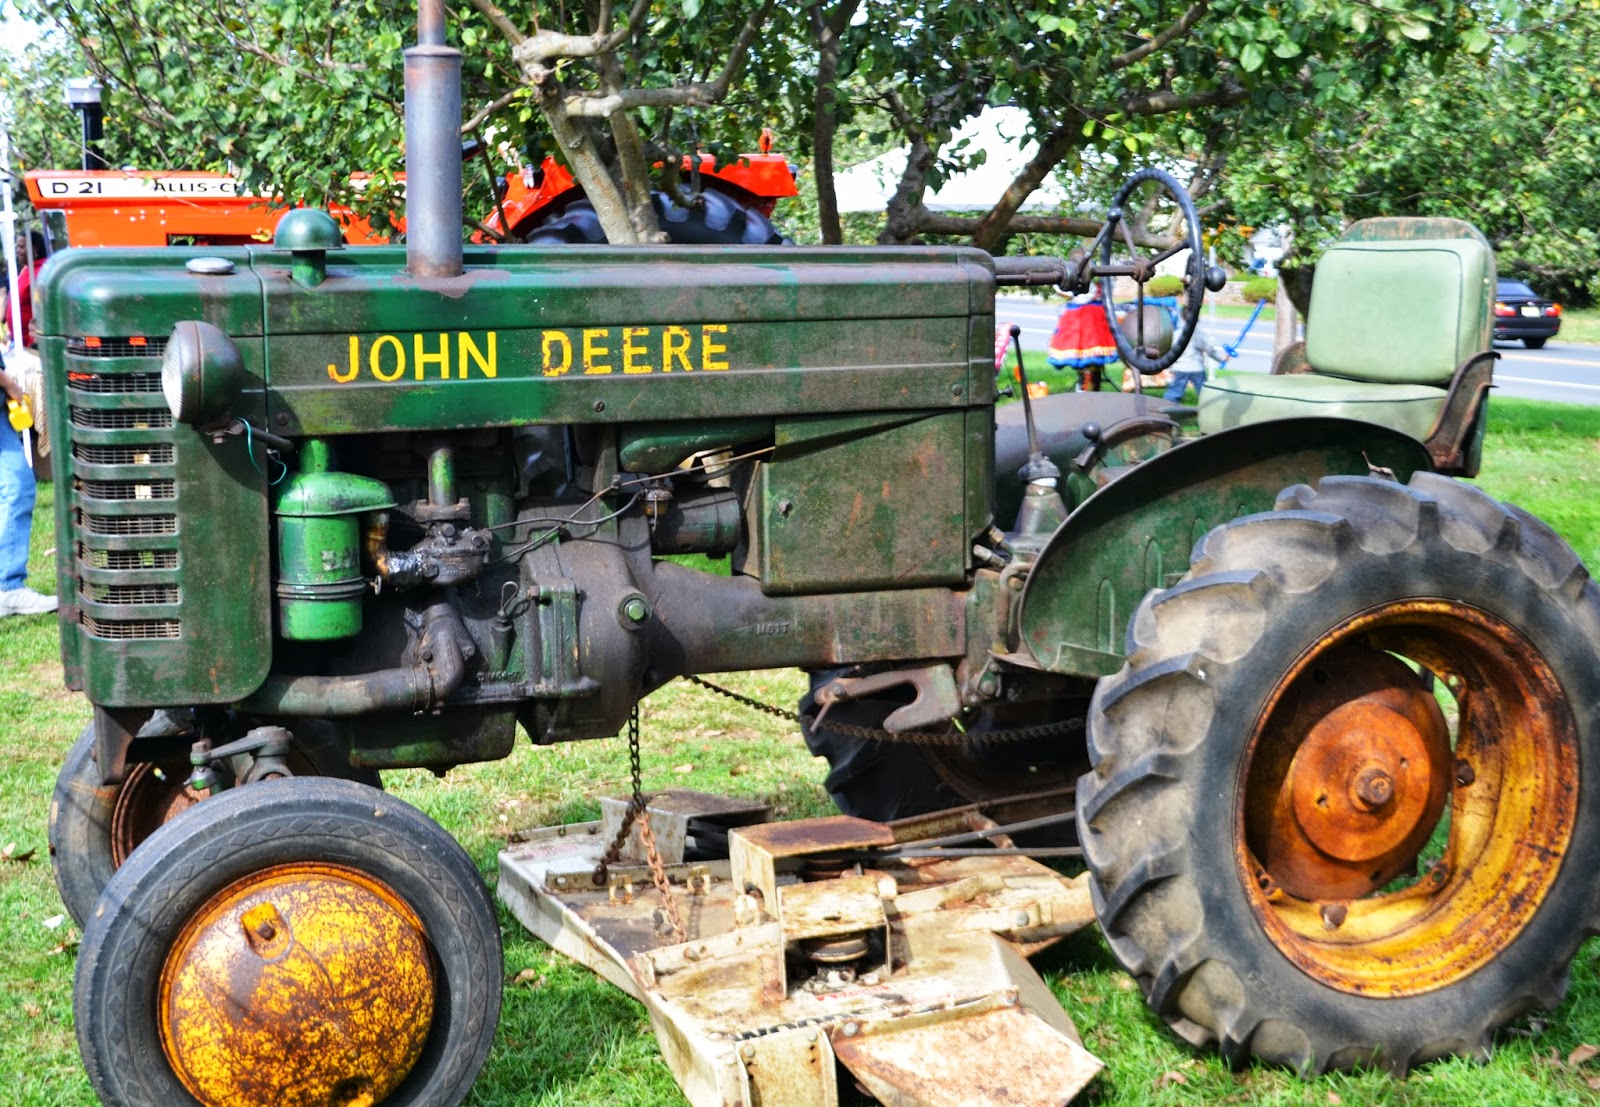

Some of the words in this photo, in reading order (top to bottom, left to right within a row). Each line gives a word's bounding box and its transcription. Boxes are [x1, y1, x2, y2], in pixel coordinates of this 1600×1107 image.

[52, 182, 69, 194] D
[78, 181, 102, 194] 21
[327, 331, 497, 384] JOHN
[541, 324, 730, 378] DEERE
